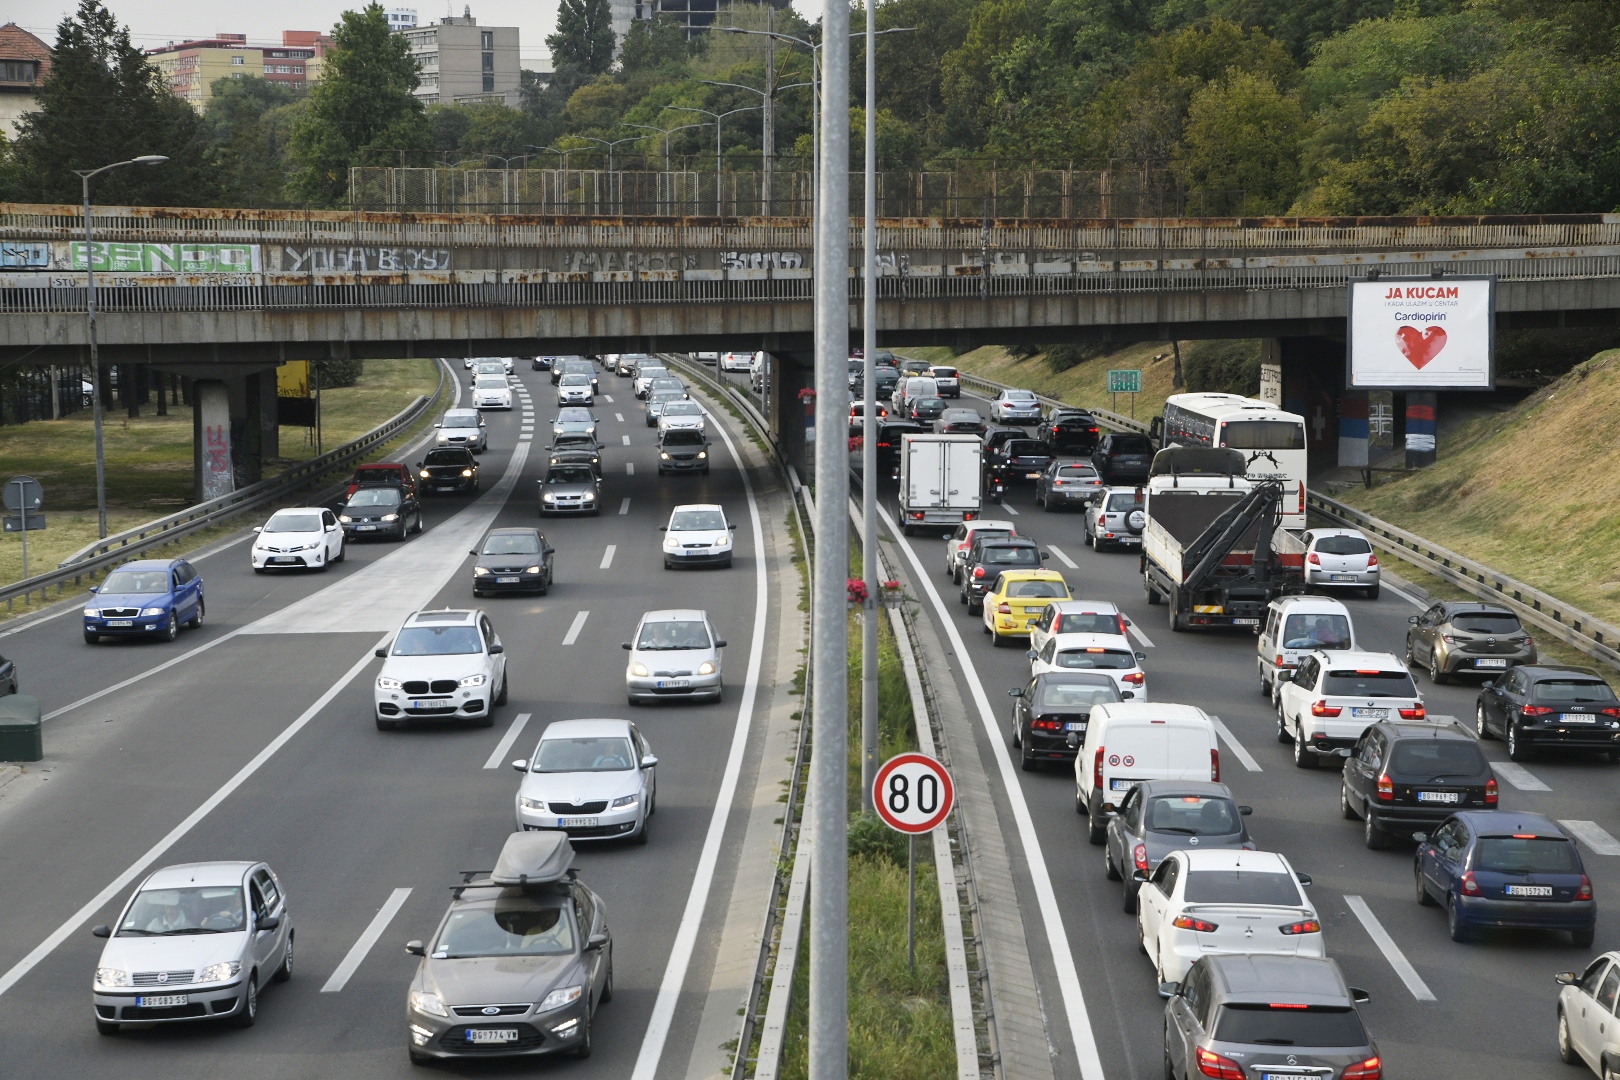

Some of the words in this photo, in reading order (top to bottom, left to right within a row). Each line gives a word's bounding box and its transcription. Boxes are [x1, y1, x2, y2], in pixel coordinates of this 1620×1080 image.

[1385, 287, 1403, 299] JA
[1406, 287, 1459, 299] KUCAM
[1394, 312, 1447, 322] Cardiopirin
[889, 773, 938, 814] 80
